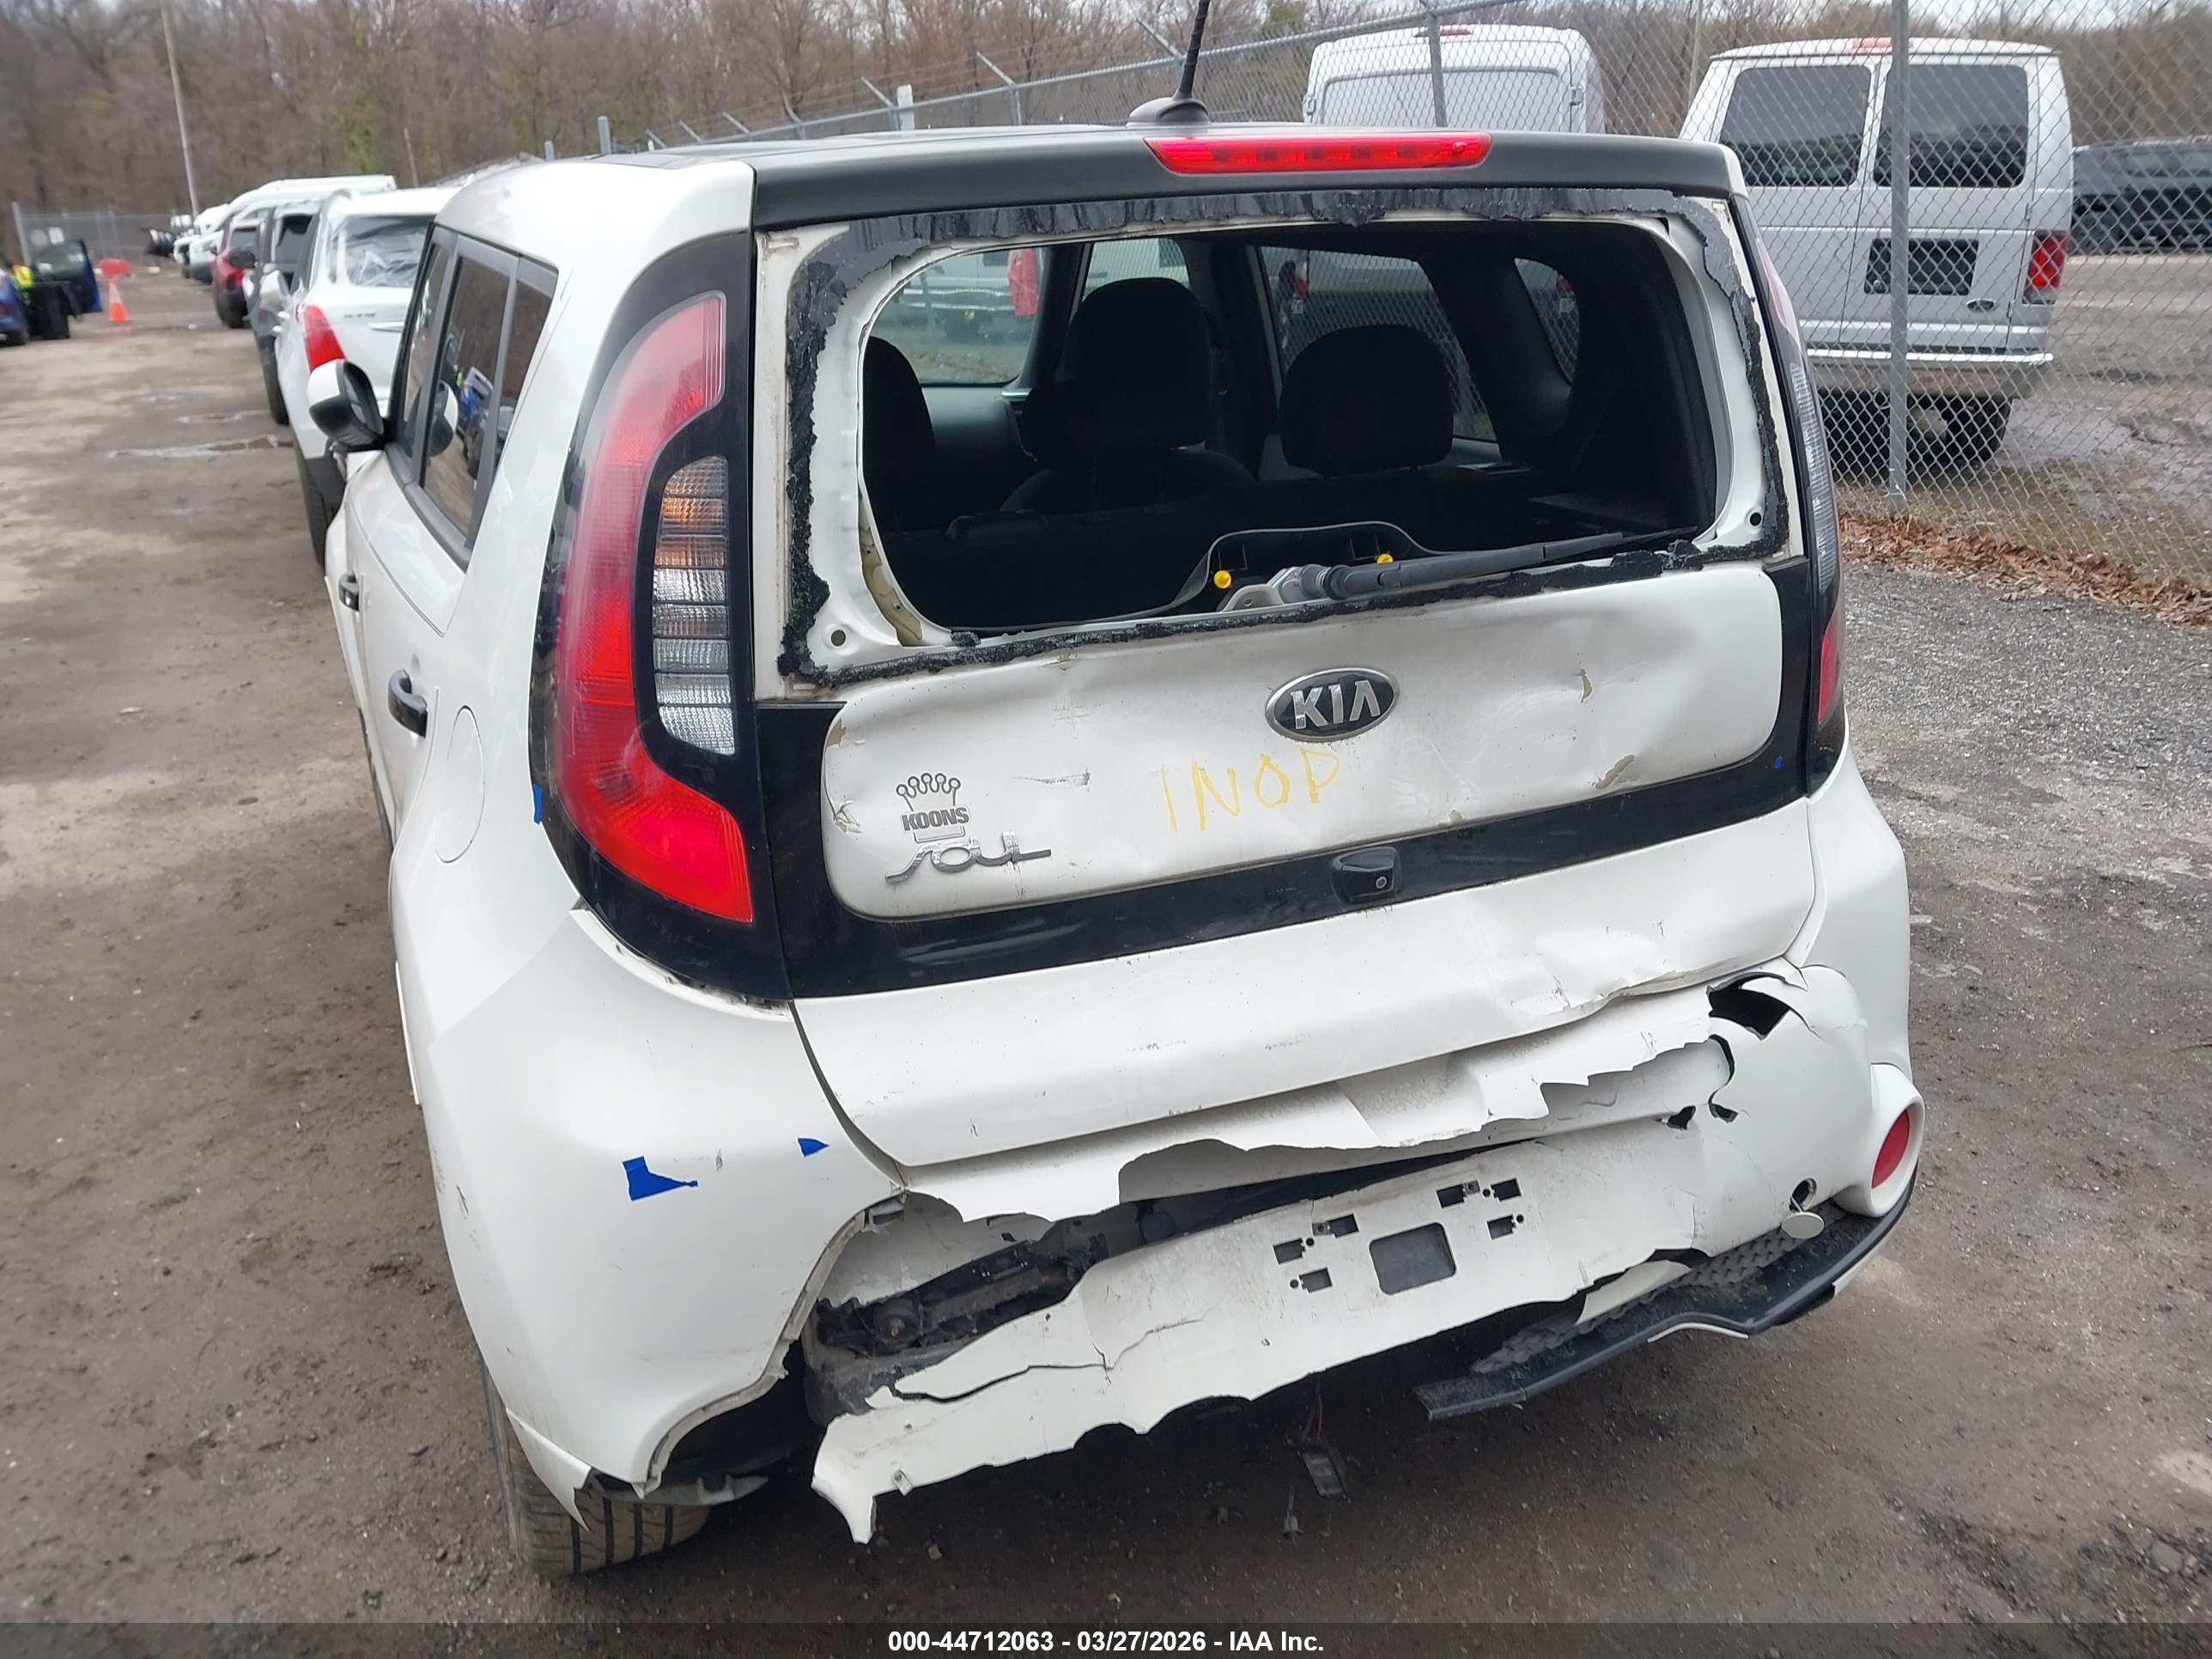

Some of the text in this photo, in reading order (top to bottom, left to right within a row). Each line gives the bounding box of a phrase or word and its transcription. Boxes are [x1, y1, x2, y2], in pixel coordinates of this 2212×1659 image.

[1290, 679, 1382, 730] KIA
[1161, 746, 1340, 832] INOP
[902, 805, 969, 832] KOONS
